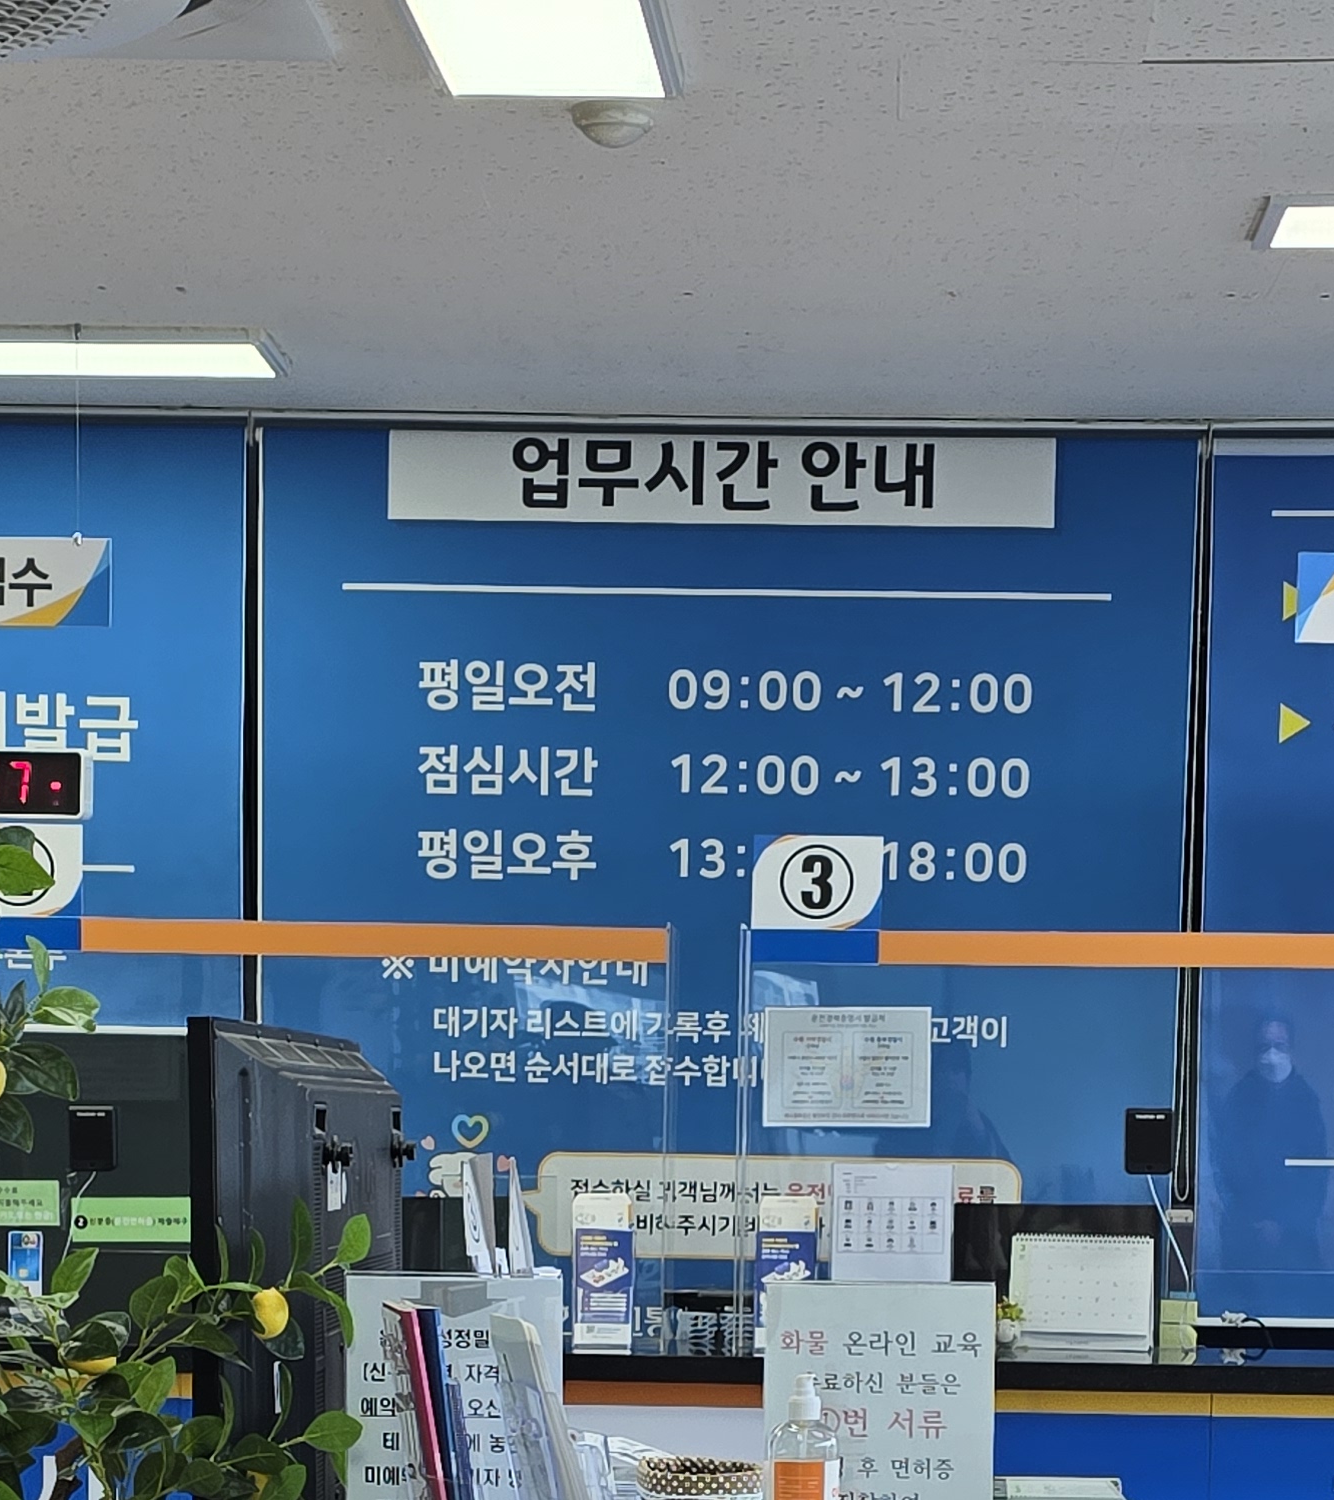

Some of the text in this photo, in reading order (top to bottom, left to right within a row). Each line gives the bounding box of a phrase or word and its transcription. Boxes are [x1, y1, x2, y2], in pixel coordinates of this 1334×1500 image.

[513, 437, 936, 513] 업무시간 안내
[418, 659, 598, 713] 평일오전
[669, 668, 821, 713] 09:00
[883, 672, 1033, 714] 12:00
[418, 744, 598, 798] 점심시간
[670, 753, 820, 797] 12:00
[881, 756, 1030, 799] 13:00
[417, 828, 1028, 883] 평일오후 13: 18:00
[433, 1006, 518, 1039] 대기자
[526, 1008, 639, 1041] 리스트에
[930, 1015, 1008, 1048] 고객이
[433, 1050, 516, 1082] 나오면
[525, 1051, 638, 1084] 순서대로
[780, 1329, 982, 1357] 화물 온라인 교육
[896, 1373, 961, 1395] 분들은
[888, 1408, 947, 1439] 서류
[857, 1456, 954, 1480] 후 면허증
